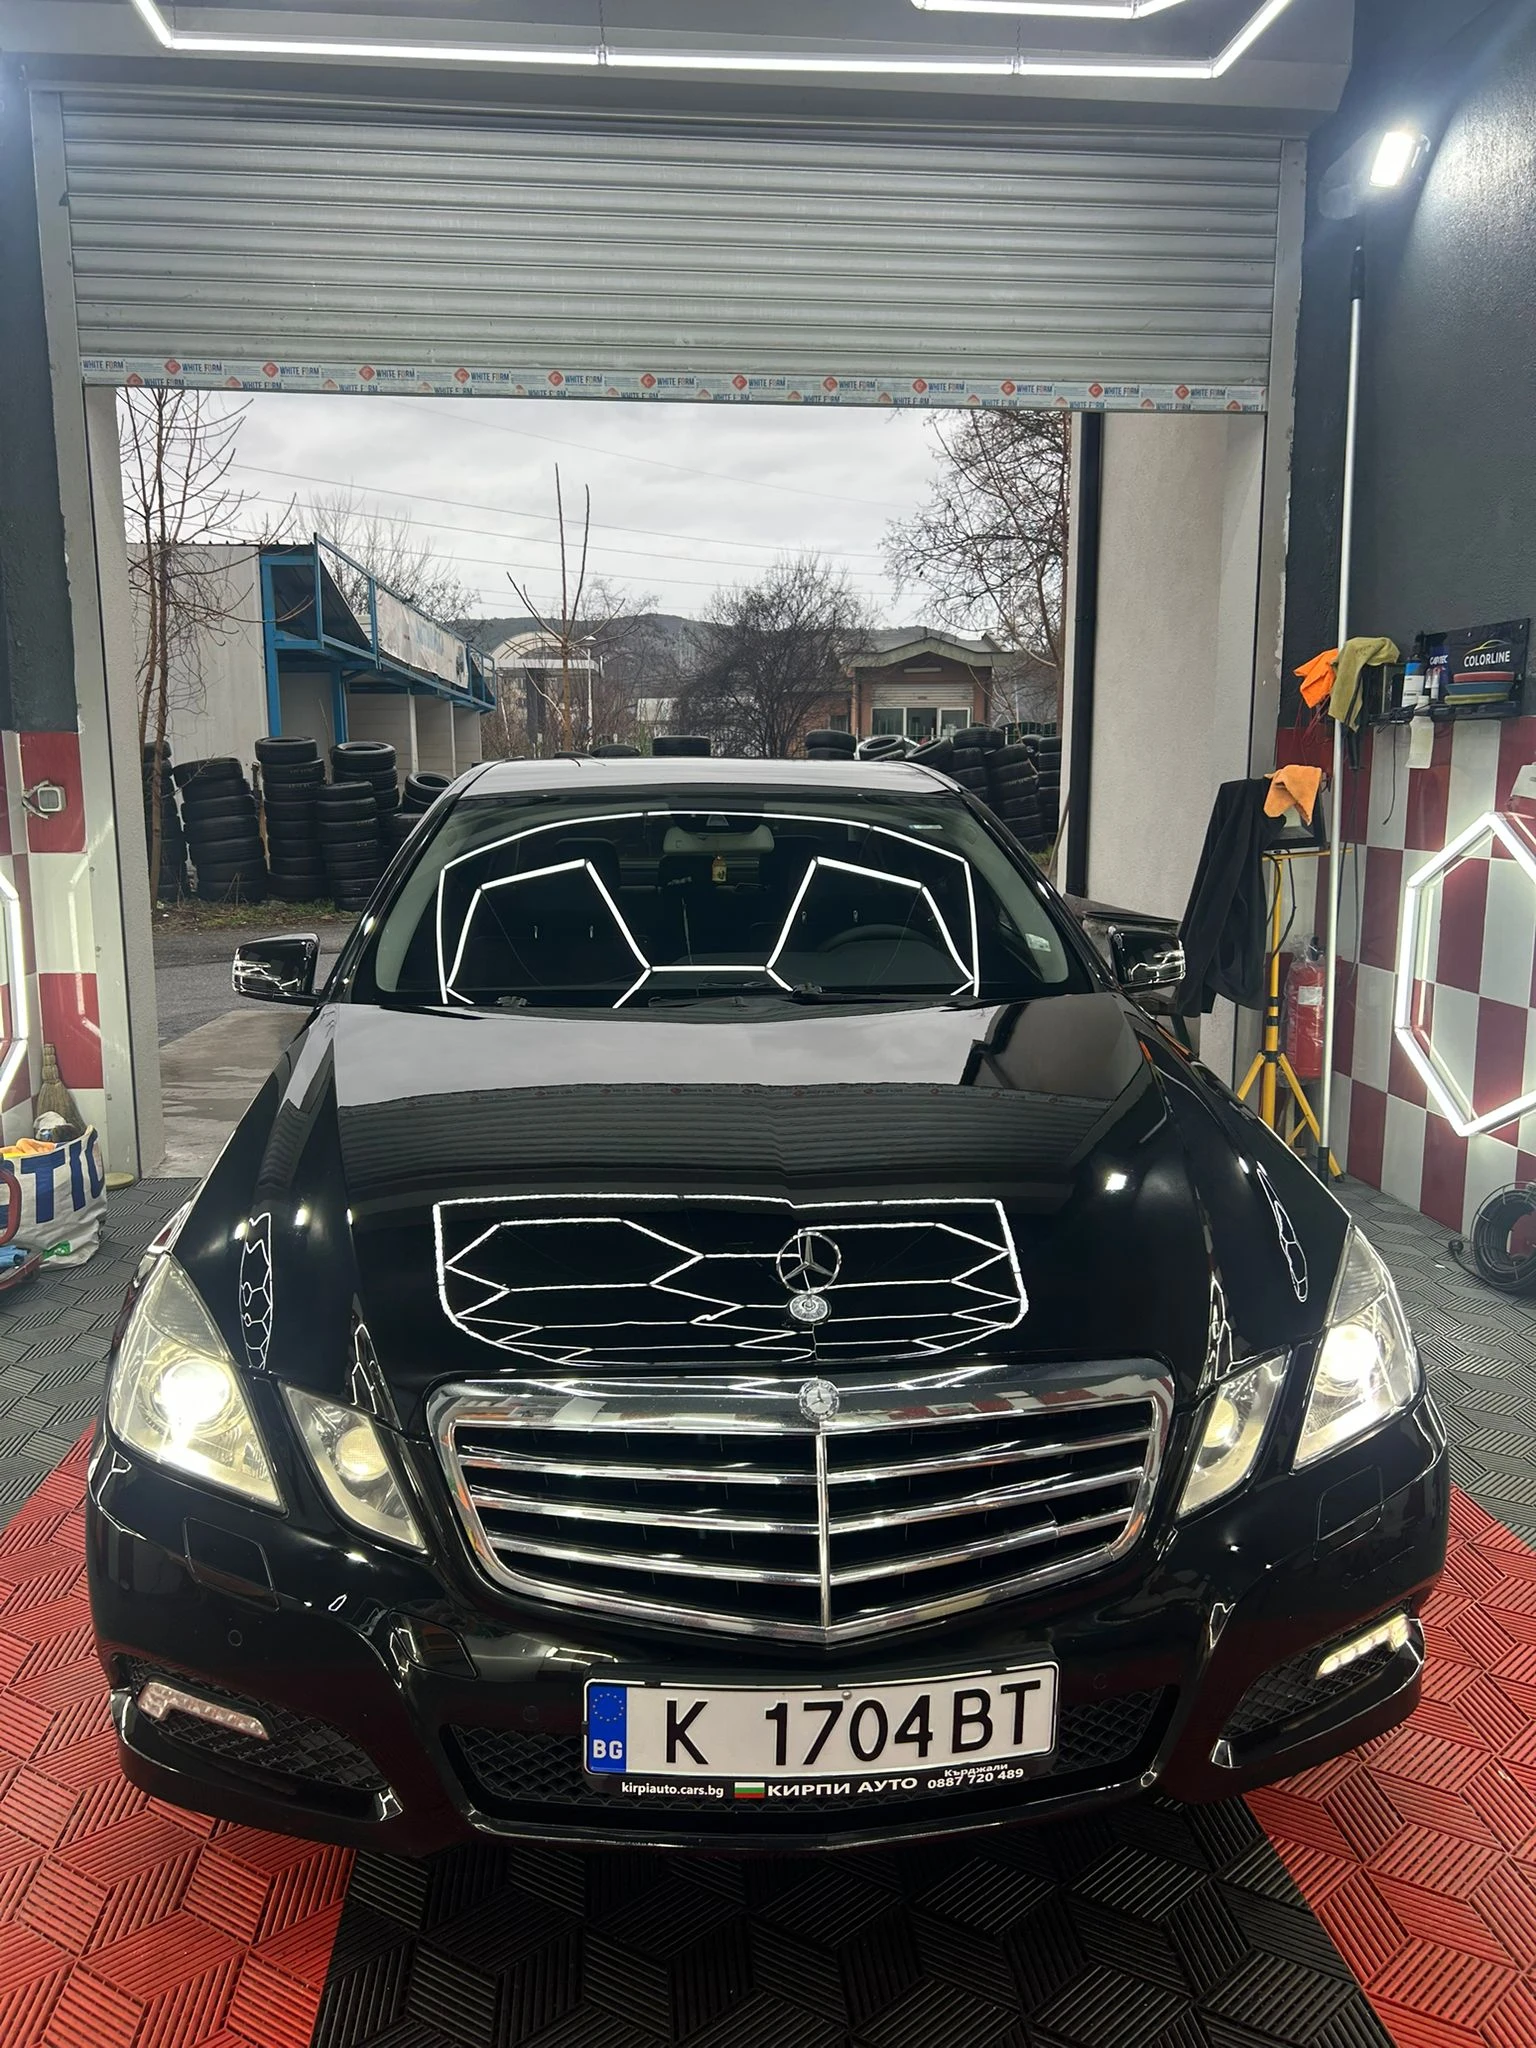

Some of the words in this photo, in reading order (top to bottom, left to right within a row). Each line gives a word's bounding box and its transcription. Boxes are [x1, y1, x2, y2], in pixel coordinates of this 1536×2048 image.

[83, 360, 103, 369] WHITE
[182, 363, 202, 371] WHITE
[279, 366, 300, 375] WHITE
[376, 369, 396, 378] WHITE
[471, 372, 490, 381] WHITE
[565, 374, 584, 383] WHITE
[657, 377, 676, 386] WHITE
[749, 378, 767, 387] WHITE
[839, 380, 858, 389] WHITE
[928, 383, 947, 391] WHITE
[1017, 384, 1035, 393] WHITE
[1104, 387, 1122, 395] WHITE
[1191, 388, 1208, 396] WHITE
[1464, 651, 1510, 667] COLORLINE
[666, 1700, 708, 1765] K
[592, 1739, 623, 1759] BG
[944, 1763, 1008, 1778] Кърджали
[927, 1776, 962, 1789] 0887
[967, 1772, 994, 1784] 720
[997, 1768, 1024, 1781] 489
[621, 1782, 724, 1798] kirpiauto.cars.bg
[767, 1782, 851, 1797] КИРПИ
[857, 1777, 918, 1793] АУТО
